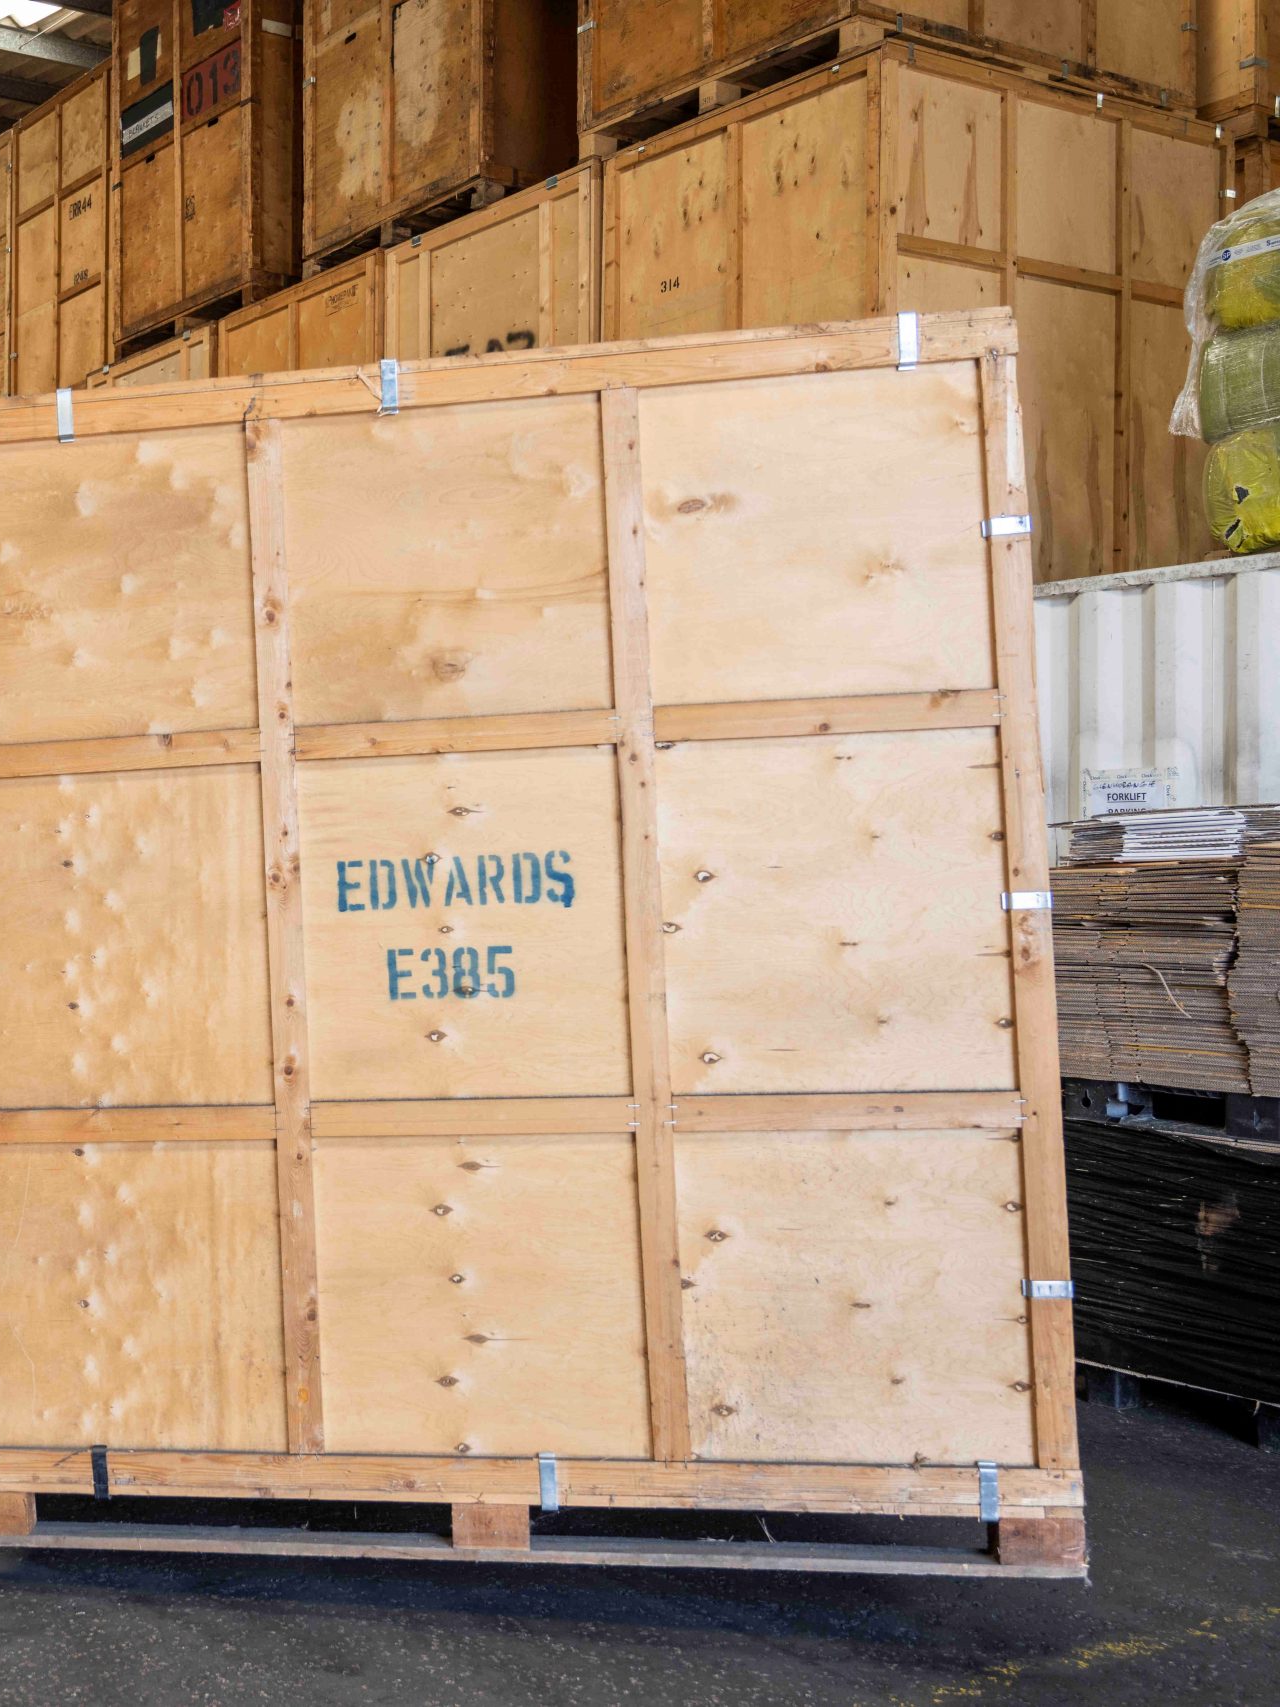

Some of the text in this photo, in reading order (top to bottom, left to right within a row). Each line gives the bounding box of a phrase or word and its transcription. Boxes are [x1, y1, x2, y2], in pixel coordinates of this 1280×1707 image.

[660, 276, 680, 293] 314
[1107, 792, 1147, 801] FORKLIFT
[336, 850, 576, 912] EDWARDS
[387, 946, 516, 1001] E385
